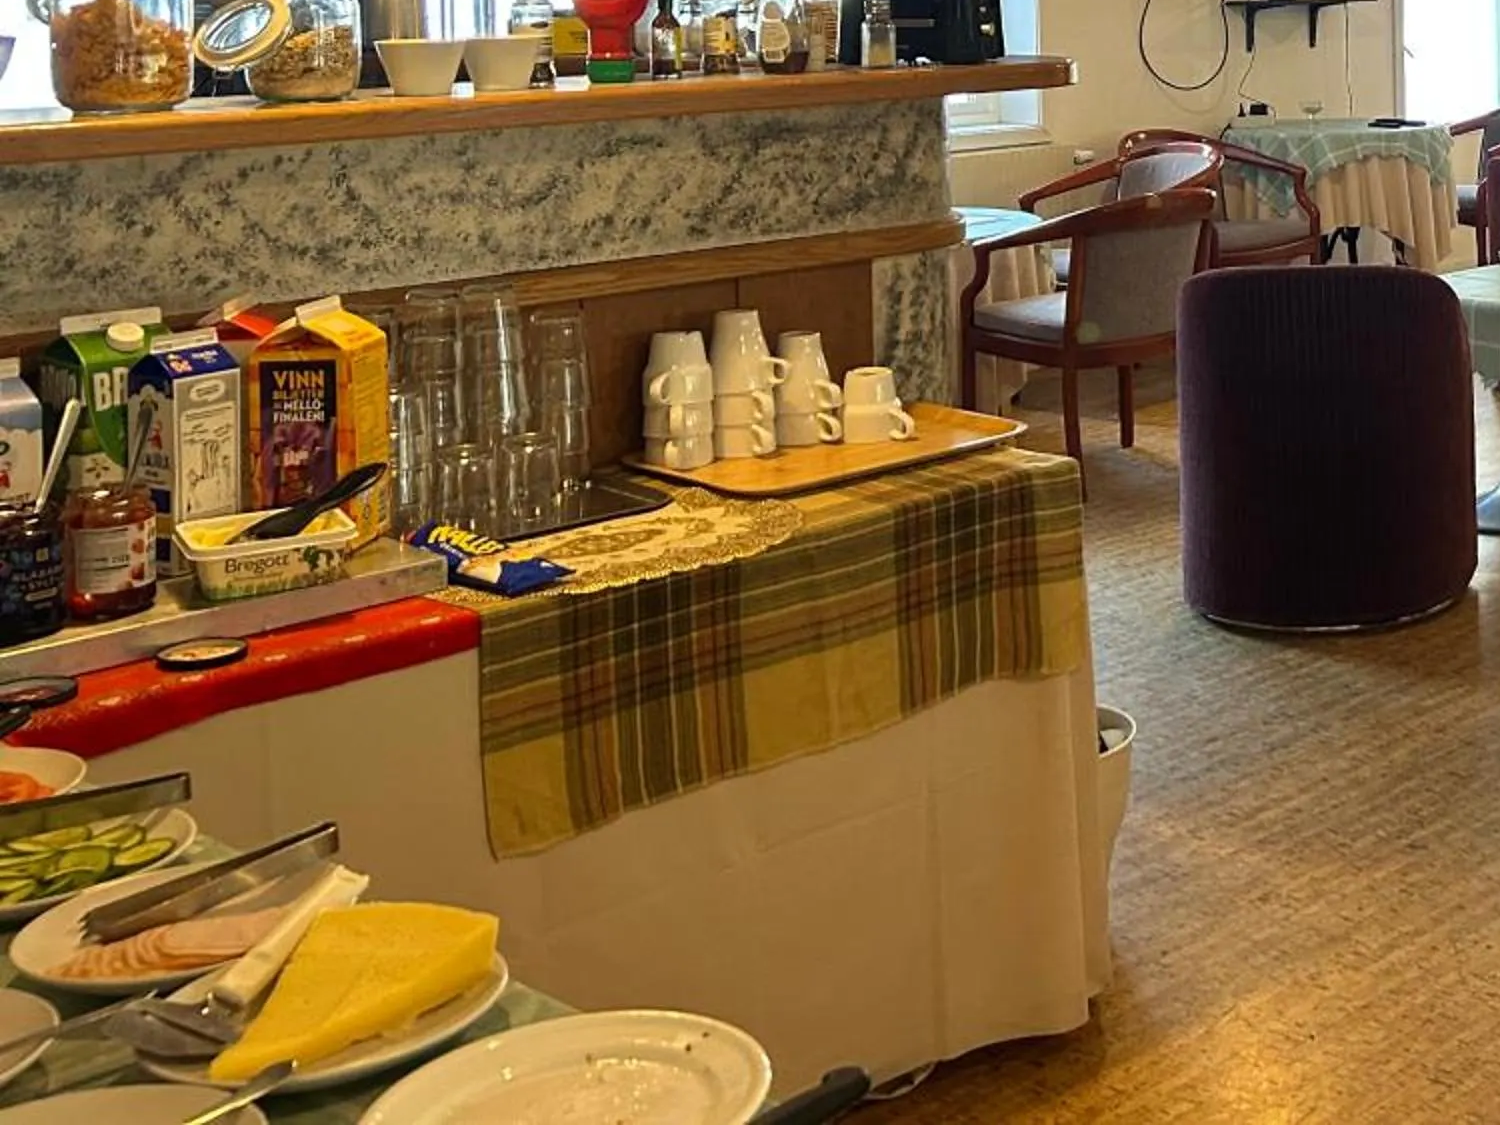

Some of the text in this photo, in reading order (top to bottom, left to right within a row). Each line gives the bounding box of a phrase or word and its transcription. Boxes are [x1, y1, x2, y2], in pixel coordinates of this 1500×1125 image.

[93, 367, 129, 412] BR
[272, 370, 325, 390] VINN
[225, 554, 289, 574] Bregott
